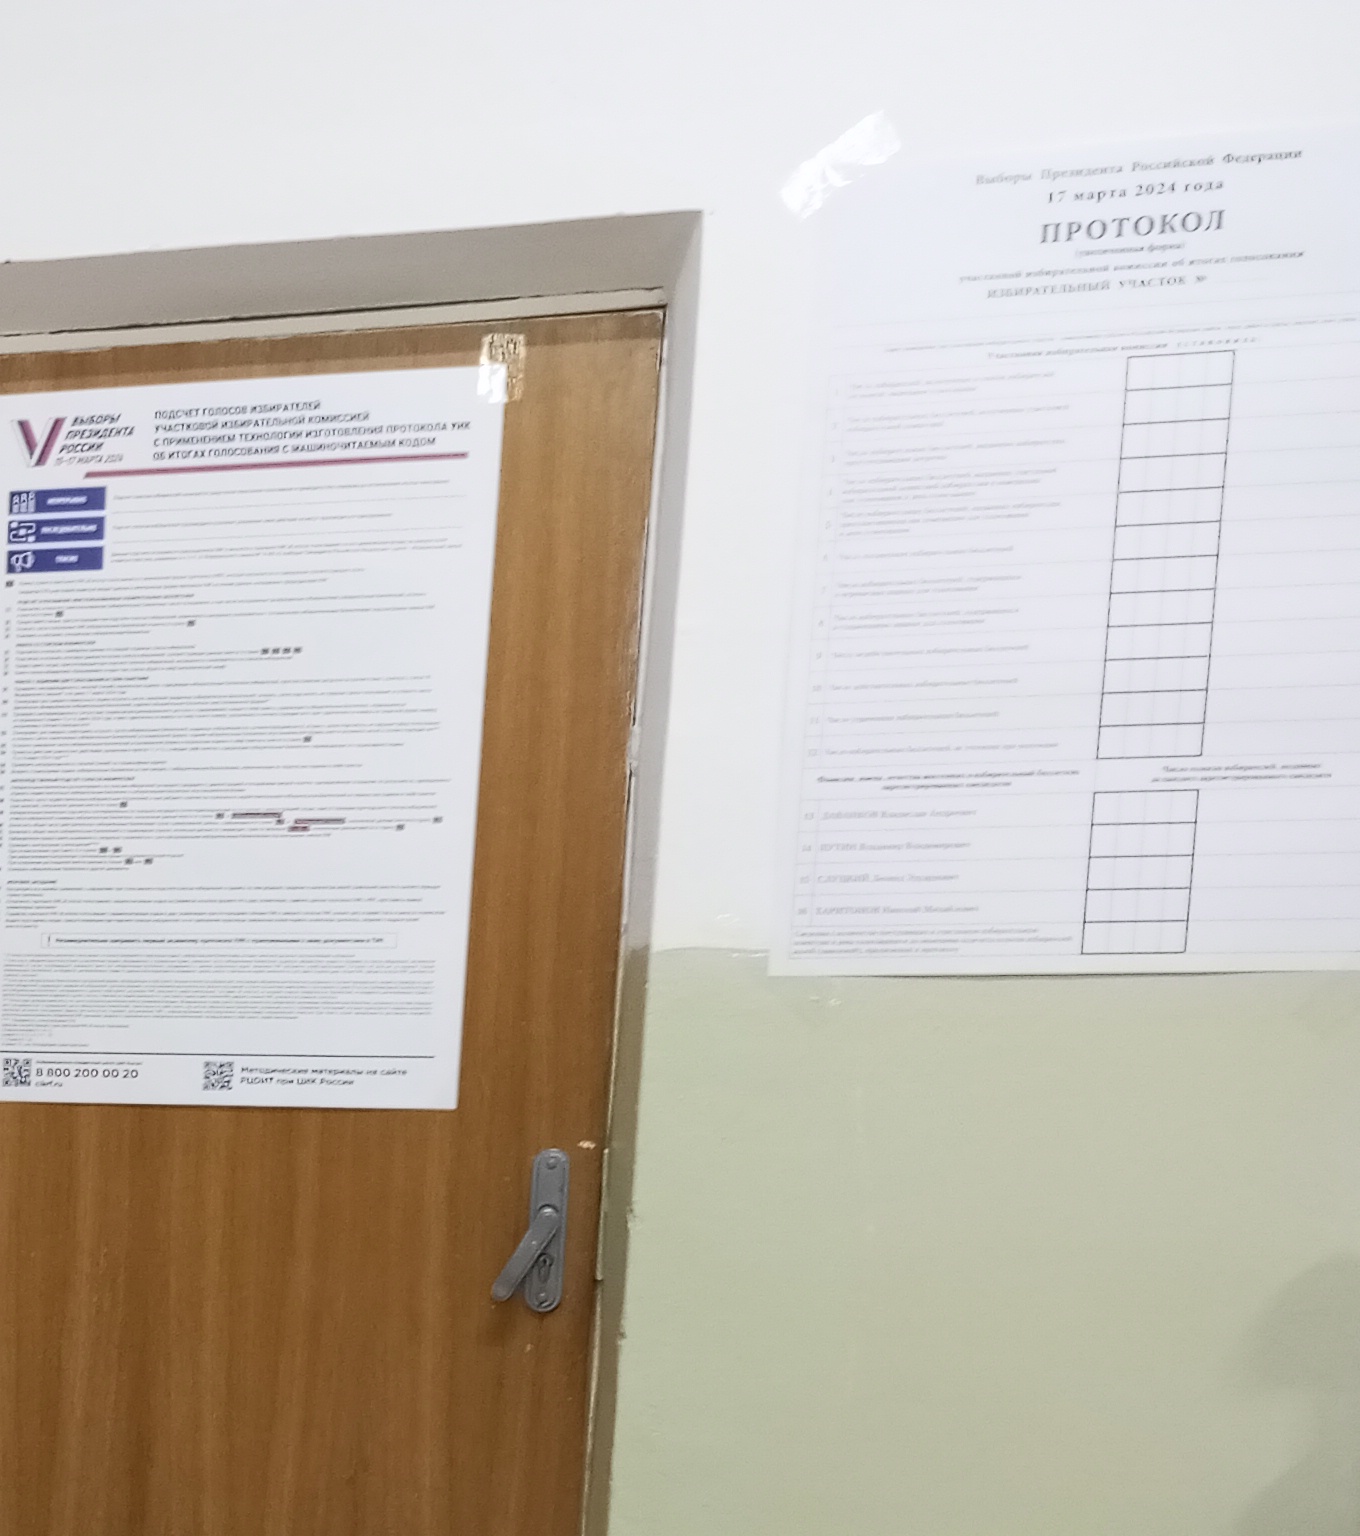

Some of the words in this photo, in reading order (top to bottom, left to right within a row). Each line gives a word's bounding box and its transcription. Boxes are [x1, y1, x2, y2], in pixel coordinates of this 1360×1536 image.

[976, 173, 1032, 185] Выборы
[1041, 165, 1123, 181] Президента
[1132, 155, 1215, 172] Российской
[1222, 150, 1303, 165] Федерации
[1048, 190, 1067, 203] 17
[1074, 188, 1127, 203] марта
[1135, 182, 1176, 197] 2024
[1183, 180, 1224, 192] года
[1040, 209, 1225, 244] ПРОТОКОЛ
[987, 280, 1111, 299] ИЗБИРАТЕЛЬНЫЙ
[1118, 275, 1187, 289] УЧАСТОК
[71, 413, 121, 426] ВЫБОРЫ
[154, 408, 200, 420] ПОДСЧЕТ
[202, 405, 247, 417] ГОЛОСОВ
[250, 400, 321, 414] ИЗБИРАТЕЛЕЙ
[65, 426, 135, 440] ПРЕЗИДЕНТА
[154, 420, 218, 433] УЧАСТКОВОЙ
[221, 415, 305, 429] ИЗБИРАТЕЛЬНОЙ
[308, 411, 370, 423] КОМИССИЕЙ
[163, 434, 236, 446] ПРИМЕНЕНИЕМ
[239, 431, 303, 442] ТЕХНОЛОГИИ
[305, 425, 383, 438] ИЗГОТОВЛЕНИЯ
[386, 422, 447, 433] ПРОТОКОЛА
[59, 442, 104, 454] РОССИИ
[153, 451, 165, 461] ОБ
[168, 449, 206, 459] ИТОГАХ
[208, 445, 280, 457] ГОЛОСОВАНИЯ
[291, 440, 396, 454] МАШИНОЧИТАЕМЫМ
[398, 437, 436, 447] КОДОМ
[36, 1068, 43, 1076] 8
[47, 1068, 71, 1077] 800
[74, 1069, 99, 1078] 200
[102, 1069, 119, 1078] 00
[122, 1069, 139, 1078] 20
